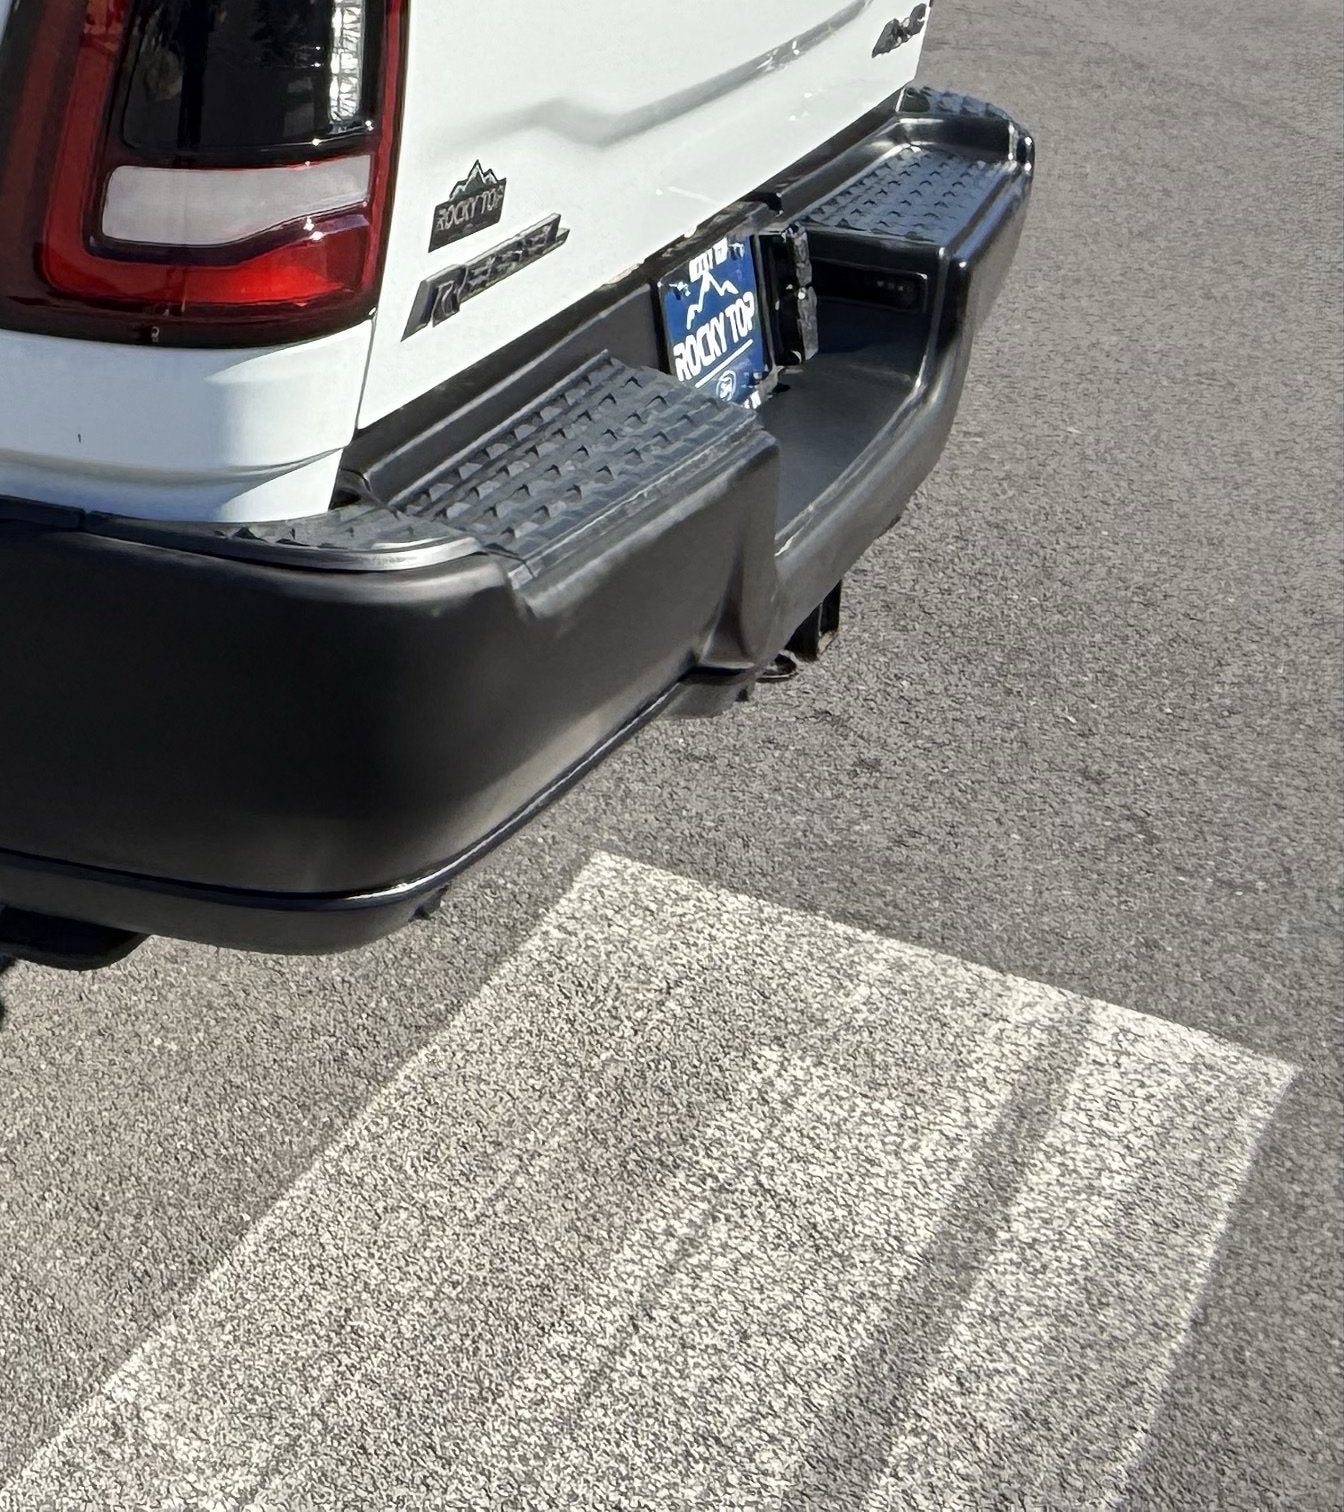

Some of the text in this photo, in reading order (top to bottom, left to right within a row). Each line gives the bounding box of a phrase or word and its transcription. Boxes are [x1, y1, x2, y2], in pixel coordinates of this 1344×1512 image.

[436, 194, 479, 232] ROCKY
[672, 291, 755, 382] ROCKY TOP
